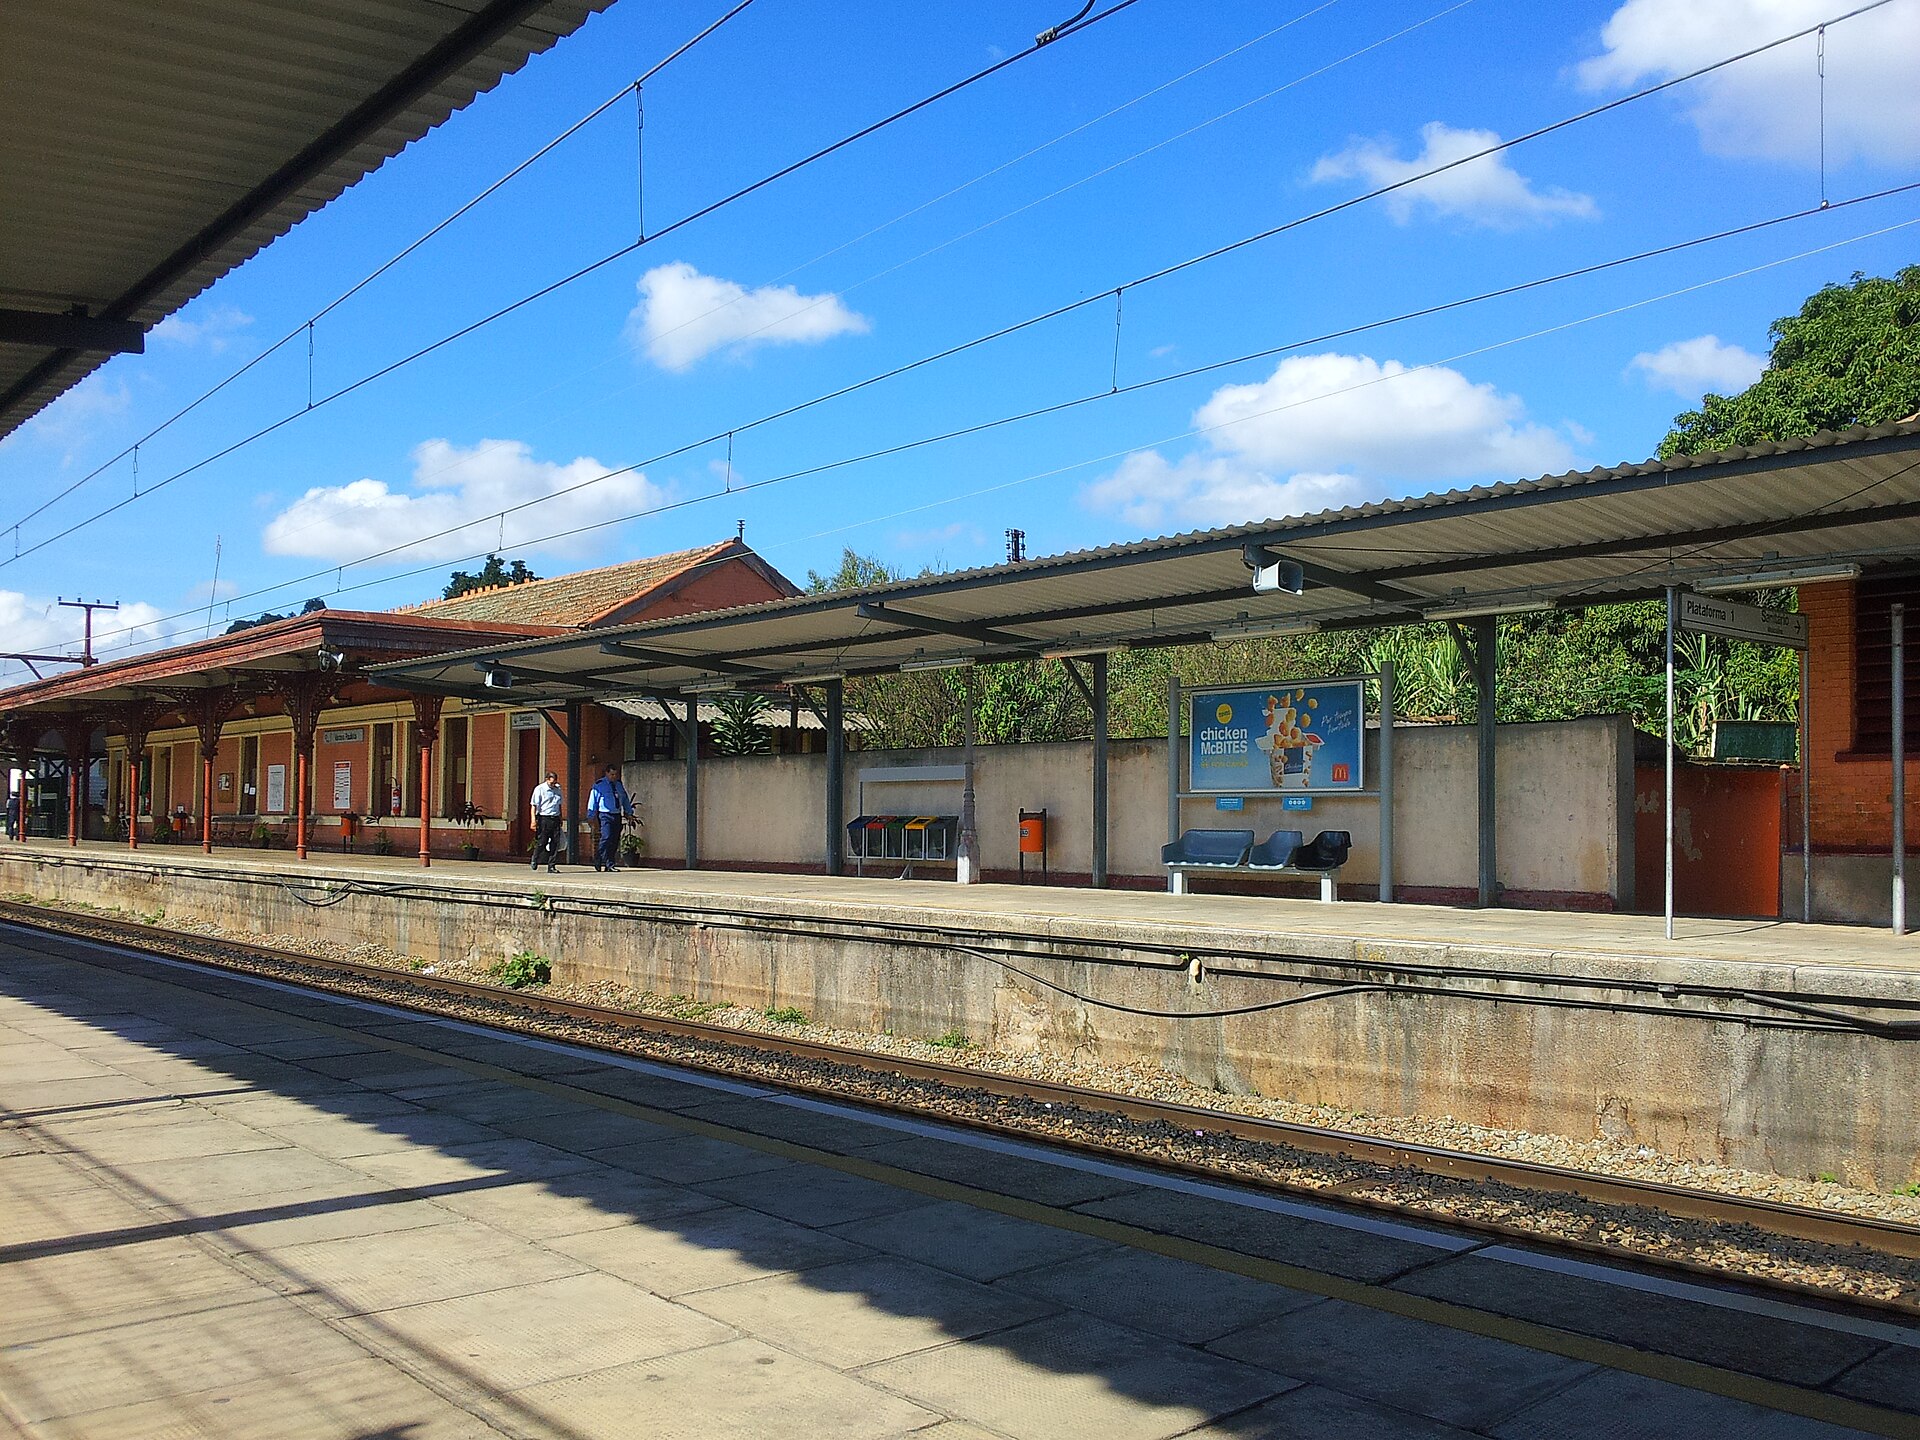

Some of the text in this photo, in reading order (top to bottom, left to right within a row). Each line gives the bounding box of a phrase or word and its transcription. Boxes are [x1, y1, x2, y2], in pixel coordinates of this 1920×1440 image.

[1686, 600, 1736, 622] Plataforma 1
[1200, 727, 1248, 740] chicken
[1200, 740, 1248, 756] McBITES
